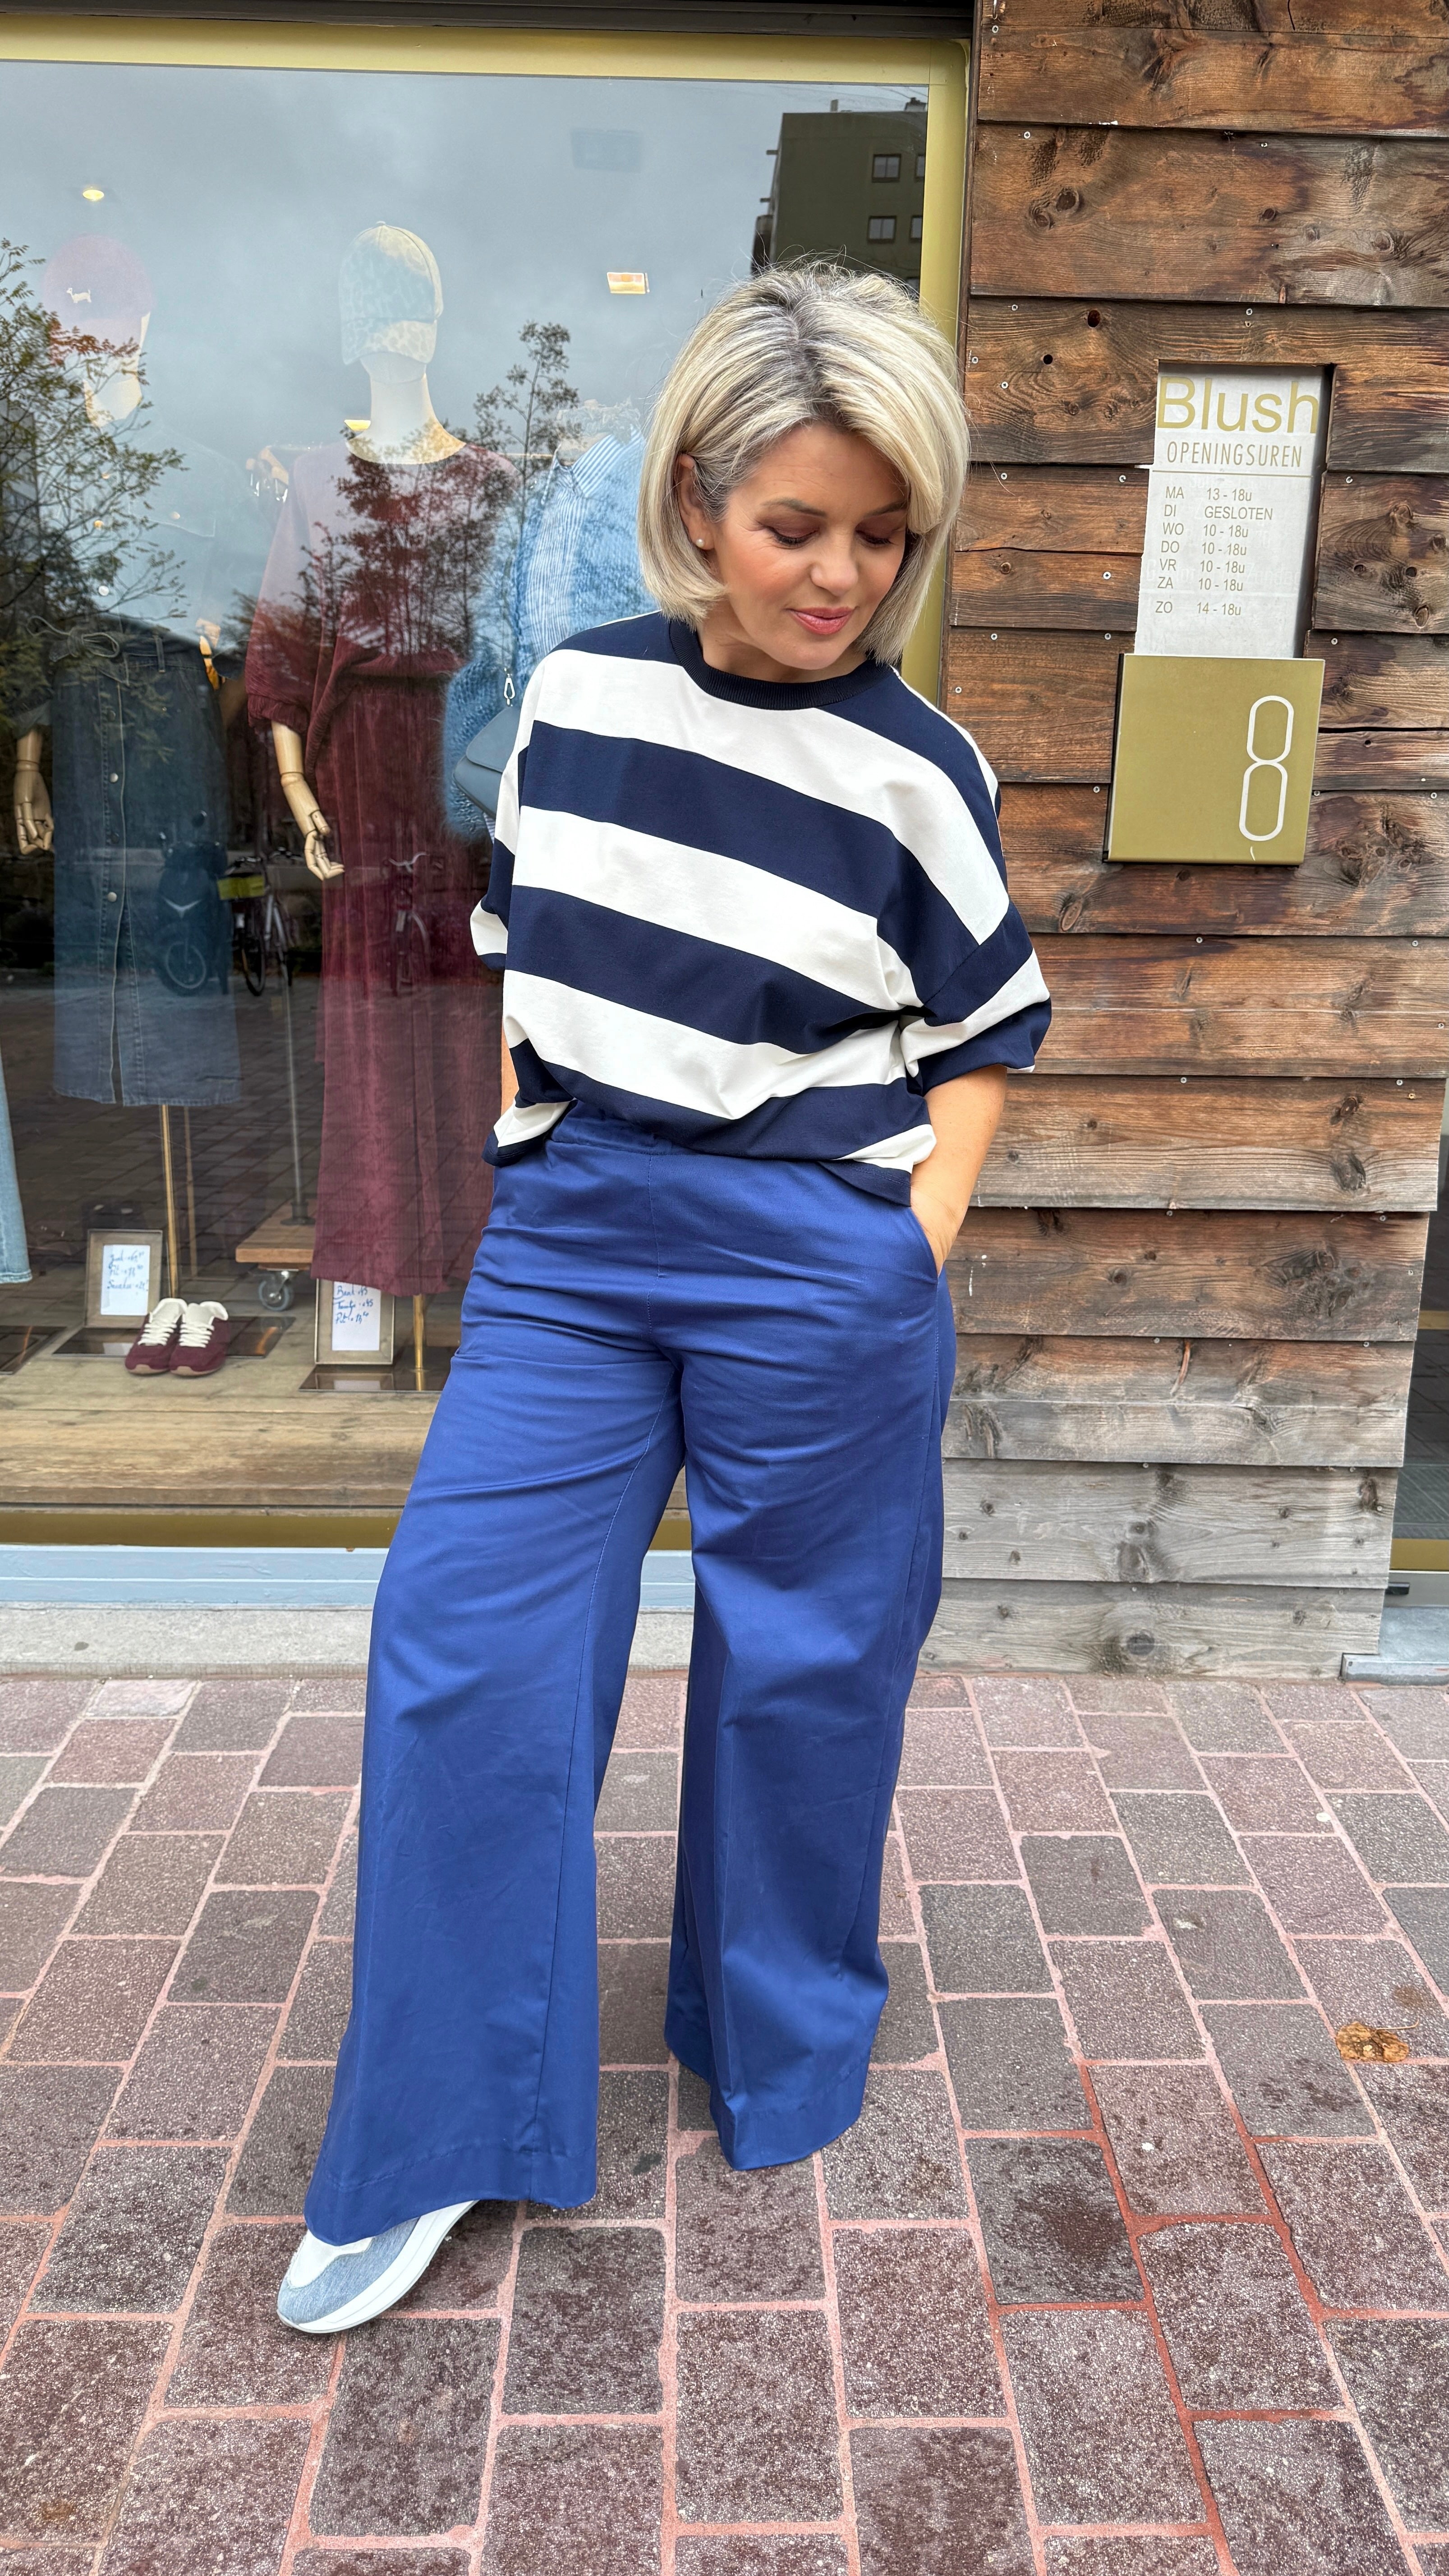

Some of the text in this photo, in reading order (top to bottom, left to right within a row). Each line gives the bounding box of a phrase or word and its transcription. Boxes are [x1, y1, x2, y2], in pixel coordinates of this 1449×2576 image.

[1157, 376, 1320, 434] Blush
[1167, 441, 1302, 467] OPENINGSUREN
[1165, 486, 1184, 499] MA
[1206, 488, 1220, 501] 13
[1232, 488, 1252, 501] 18u
[1164, 504, 1273, 520] DI GESLOTEN
[1163, 522, 1184, 535] WO
[1203, 524, 1216, 537] 10
[1228, 524, 1249, 538] 18u
[1161, 540, 1180, 553] DO
[1202, 542, 1215, 555] 10
[1227, 543, 1247, 556] 18u
[1159, 558, 1177, 571] VR
[1200, 560, 1213, 573] 10
[1225, 561, 1245, 574] 18u
[1157, 576, 1173, 589] ZA
[1198, 578, 1211, 590] 10
[1224, 579, 1243, 591] 18u
[1155, 601, 1173, 613] ZO
[1197, 602, 1210, 614] 14
[1222, 603, 1241, 616] 18u
[1239, 695, 1294, 842] 8
